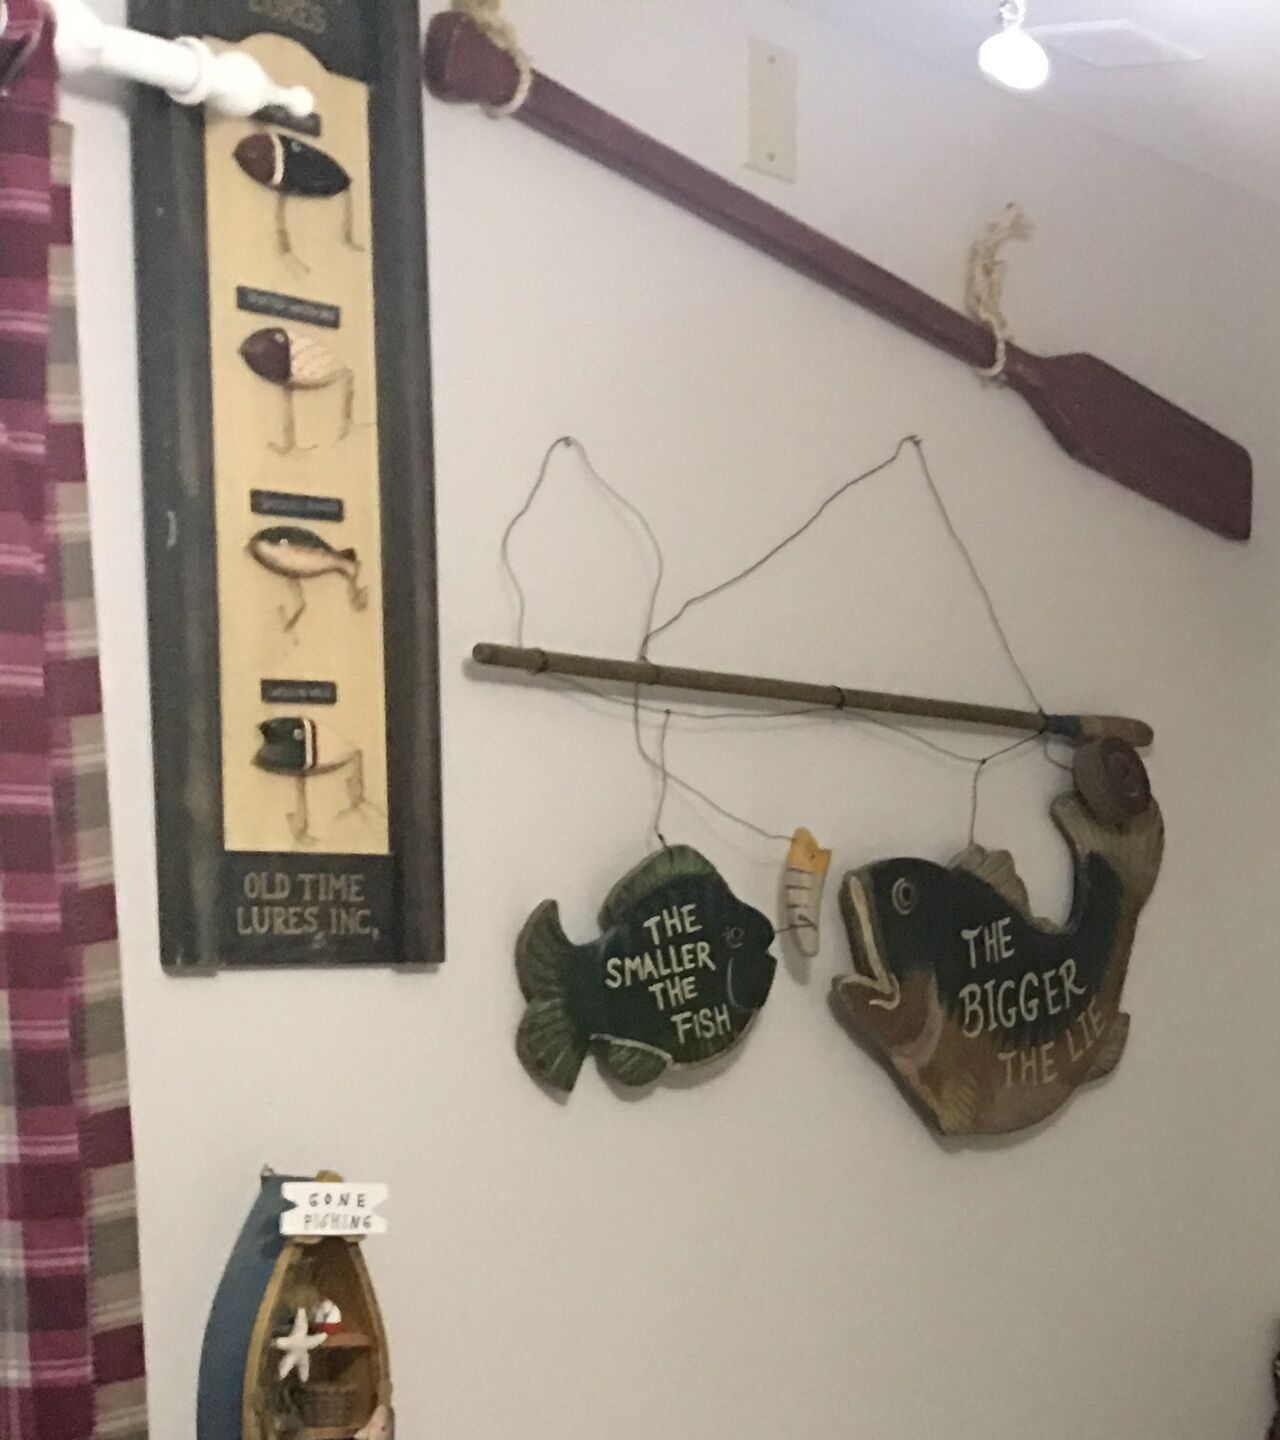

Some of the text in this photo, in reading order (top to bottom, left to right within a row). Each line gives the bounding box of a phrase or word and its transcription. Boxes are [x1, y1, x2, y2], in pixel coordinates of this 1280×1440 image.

[243, 871, 366, 902] OLD TIME
[643, 903, 703, 945] THE
[960, 916, 1015, 969] THE
[604, 941, 716, 988] SMALLER
[648, 976, 698, 1010] THE
[958, 958, 1087, 1039] BIGGER
[670, 1003, 731, 1045] FISH
[997, 995, 1107, 1089] THE LIE
[308, 1192, 366, 1208] GONE
